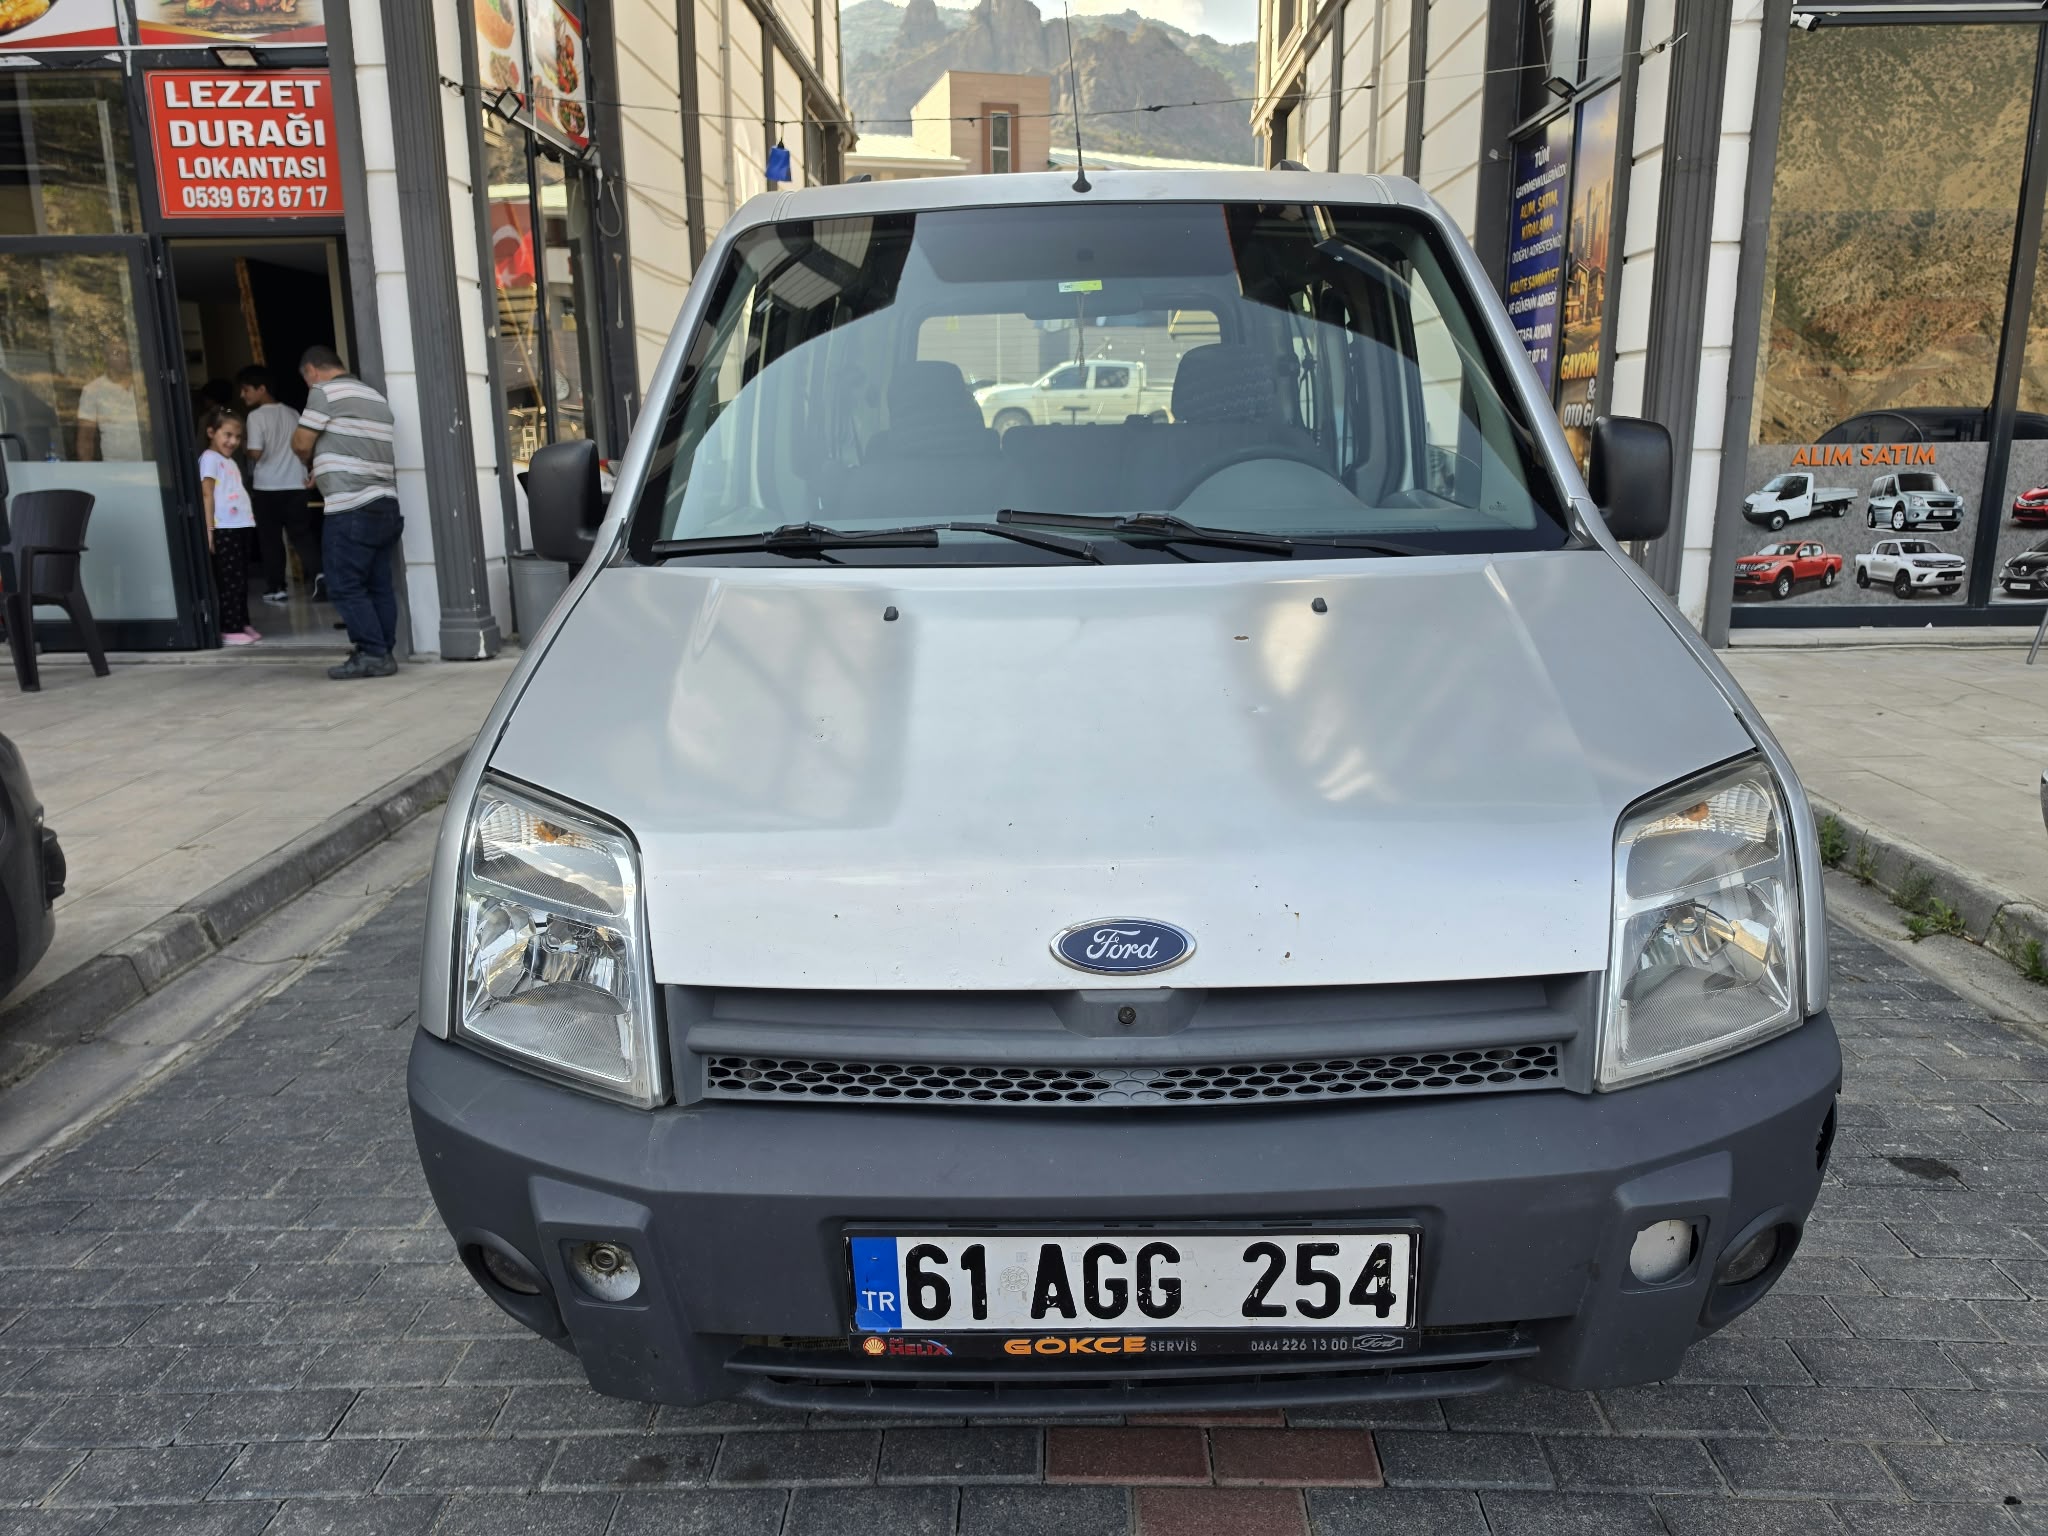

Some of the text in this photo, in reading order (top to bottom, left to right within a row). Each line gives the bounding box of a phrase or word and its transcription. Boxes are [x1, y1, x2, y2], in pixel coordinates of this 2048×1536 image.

[164, 80, 321, 109] LEZZET
[169, 113, 326, 147] DURAĞI
[1534, 145, 1550, 168] TÜM
[178, 157, 327, 179] LOKANTASI
[182, 186, 328, 208] 0539 673 67 17
[1533, 322, 1552, 340] AYDIN
[1587, 378, 1596, 400] &
[1563, 403, 1583, 427] OTO
[1791, 445, 1936, 467] ALIM SATIM
[1086, 928, 1160, 960] Ford
[906, 1242, 1397, 1321] 61 AGG 254
[862, 1291, 896, 1312] TR
[1003, 1336, 1147, 1354] GÖKÇE
[1150, 1338, 1198, 1352] SERVİS
[1251, 1341, 1278, 1351] 0464
[1282, 1338, 1307, 1351] 226
[1312, 1338, 1327, 1351] 13
[1331, 1337, 1348, 1351] 00
